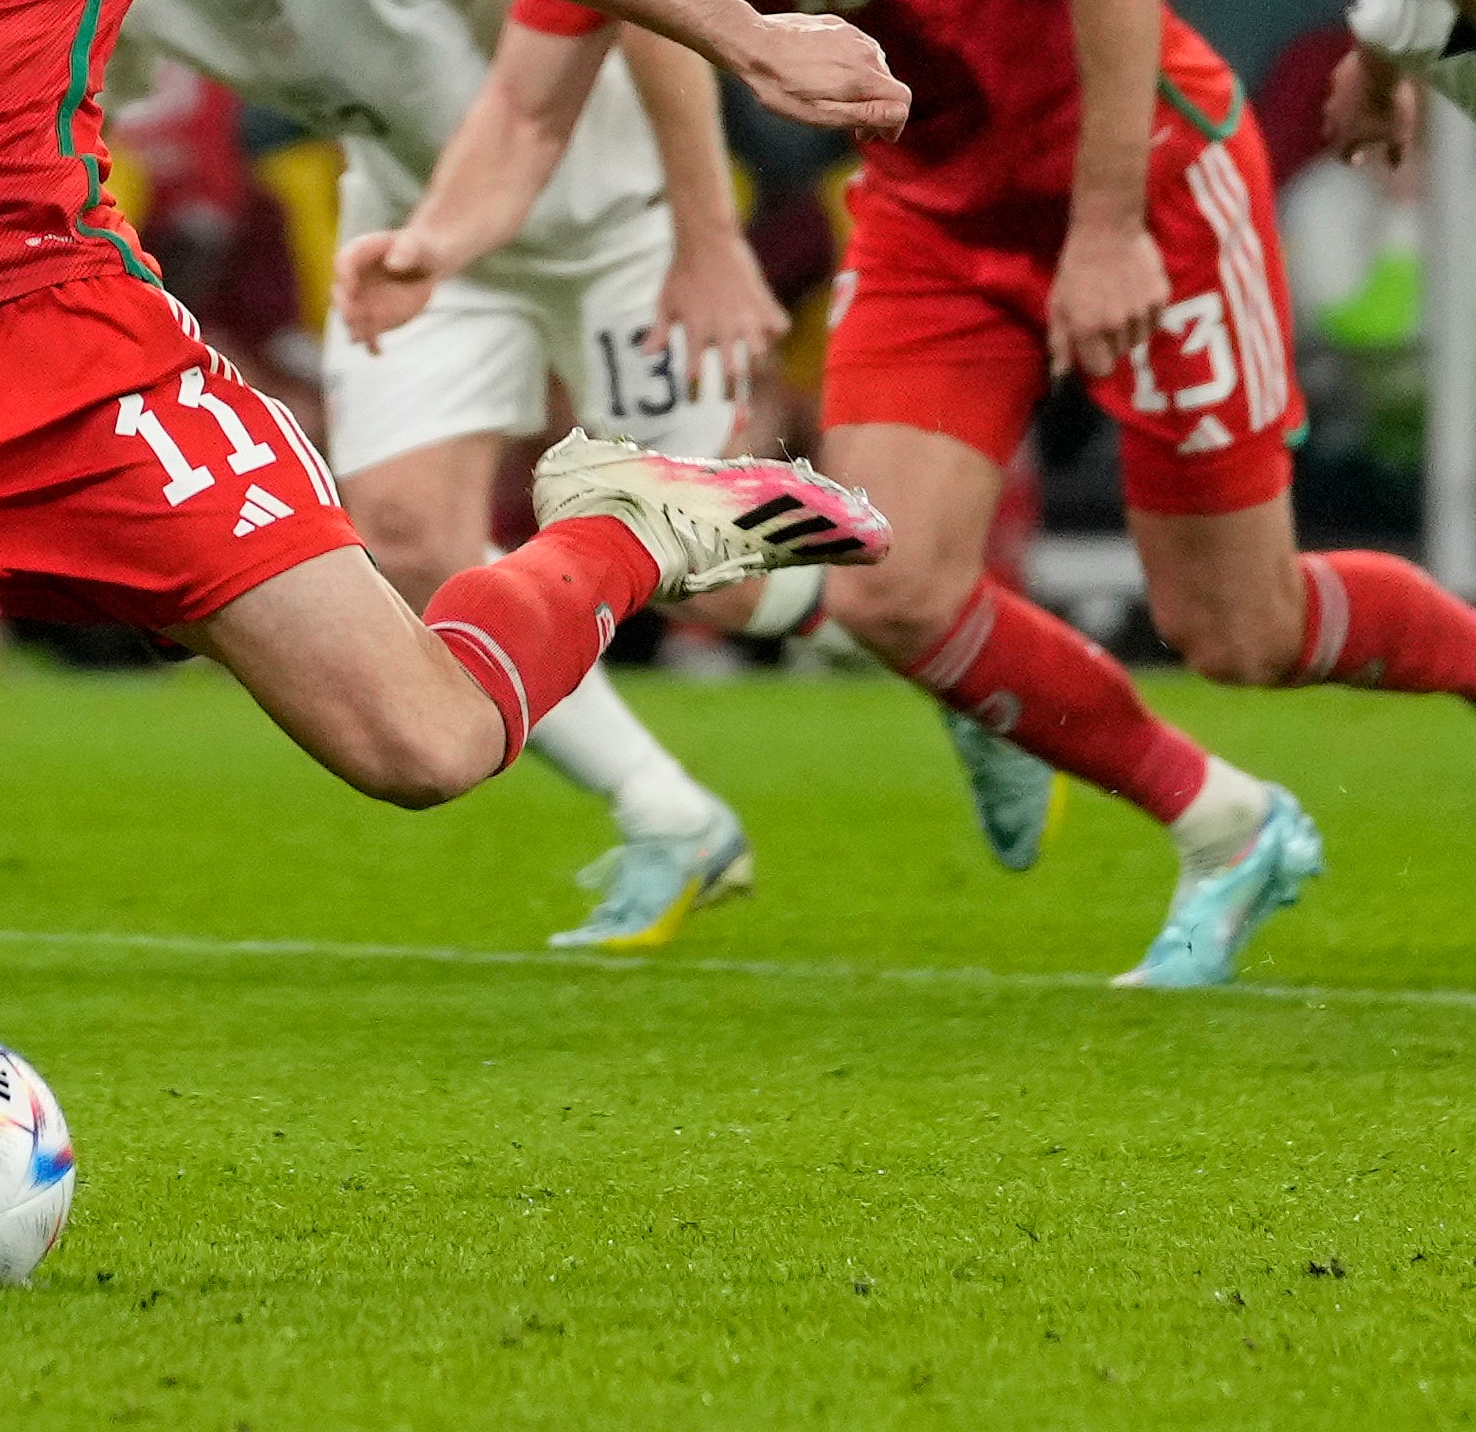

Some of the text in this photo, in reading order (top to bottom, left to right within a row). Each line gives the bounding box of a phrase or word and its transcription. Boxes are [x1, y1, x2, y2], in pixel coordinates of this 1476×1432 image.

[596, 325, 680, 418] 13
[1129, 290, 1238, 412] 13
[114, 366, 277, 508] 11
